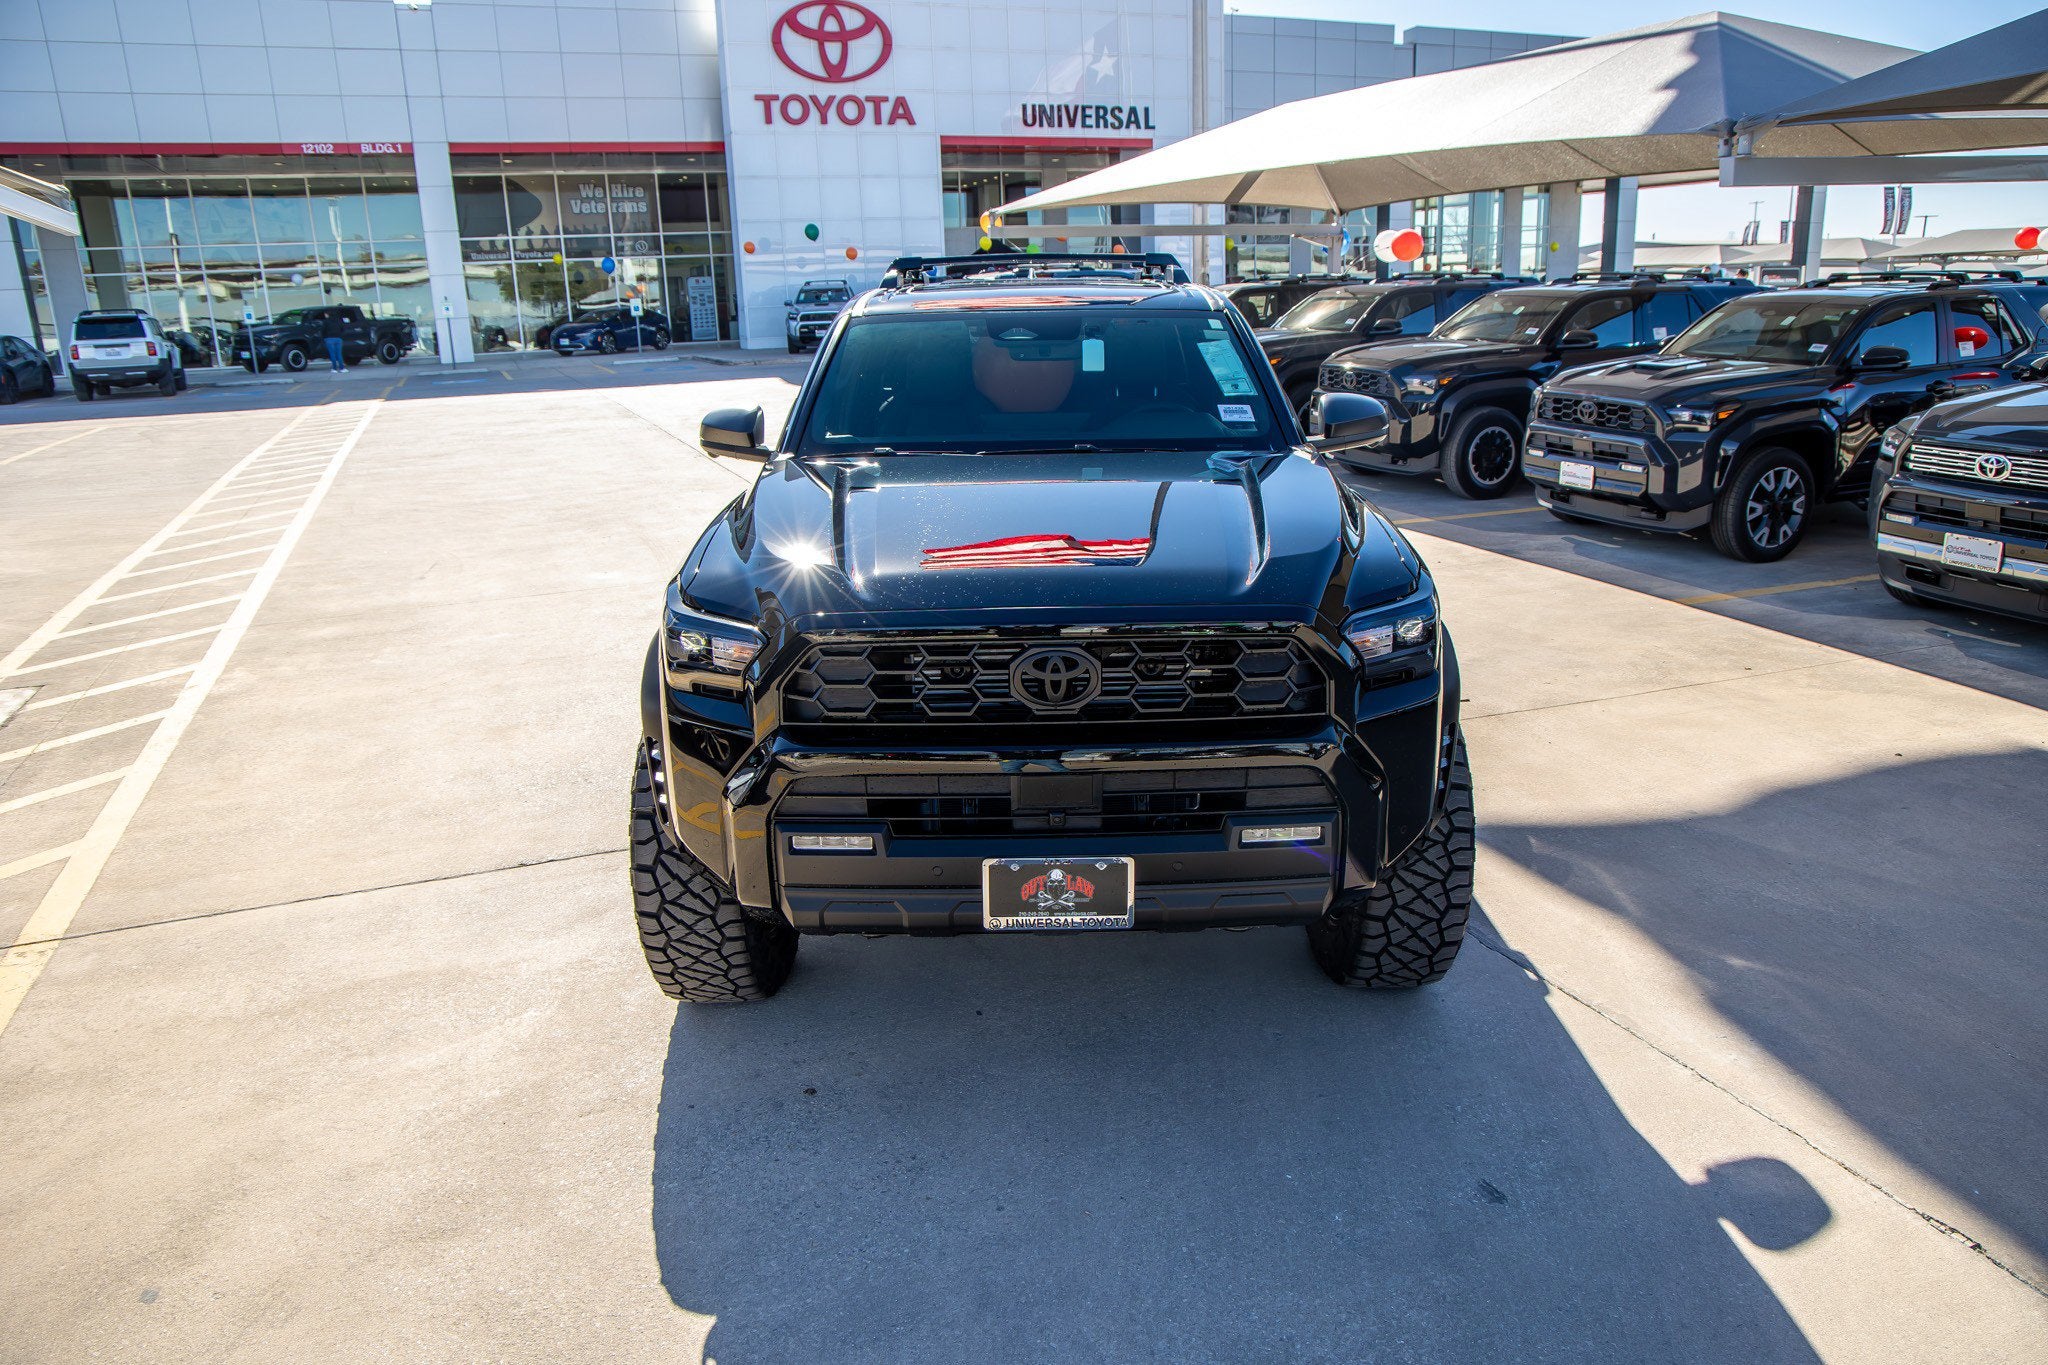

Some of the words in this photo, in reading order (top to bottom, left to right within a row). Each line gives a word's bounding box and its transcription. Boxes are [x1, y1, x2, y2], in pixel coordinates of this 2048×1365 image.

[754, 94, 917, 126] TOYOTA
[1021, 103, 1156, 130] UNIVERSAL
[301, 143, 335, 154] 12102
[395, 143, 403, 154] 1
[578, 183, 604, 198] We
[610, 183, 645, 198] Hire
[569, 199, 648, 214] Veterans
[1006, 918, 1077, 928] UNIVERSAL
[1079, 918, 1128, 928] TOYOTA
